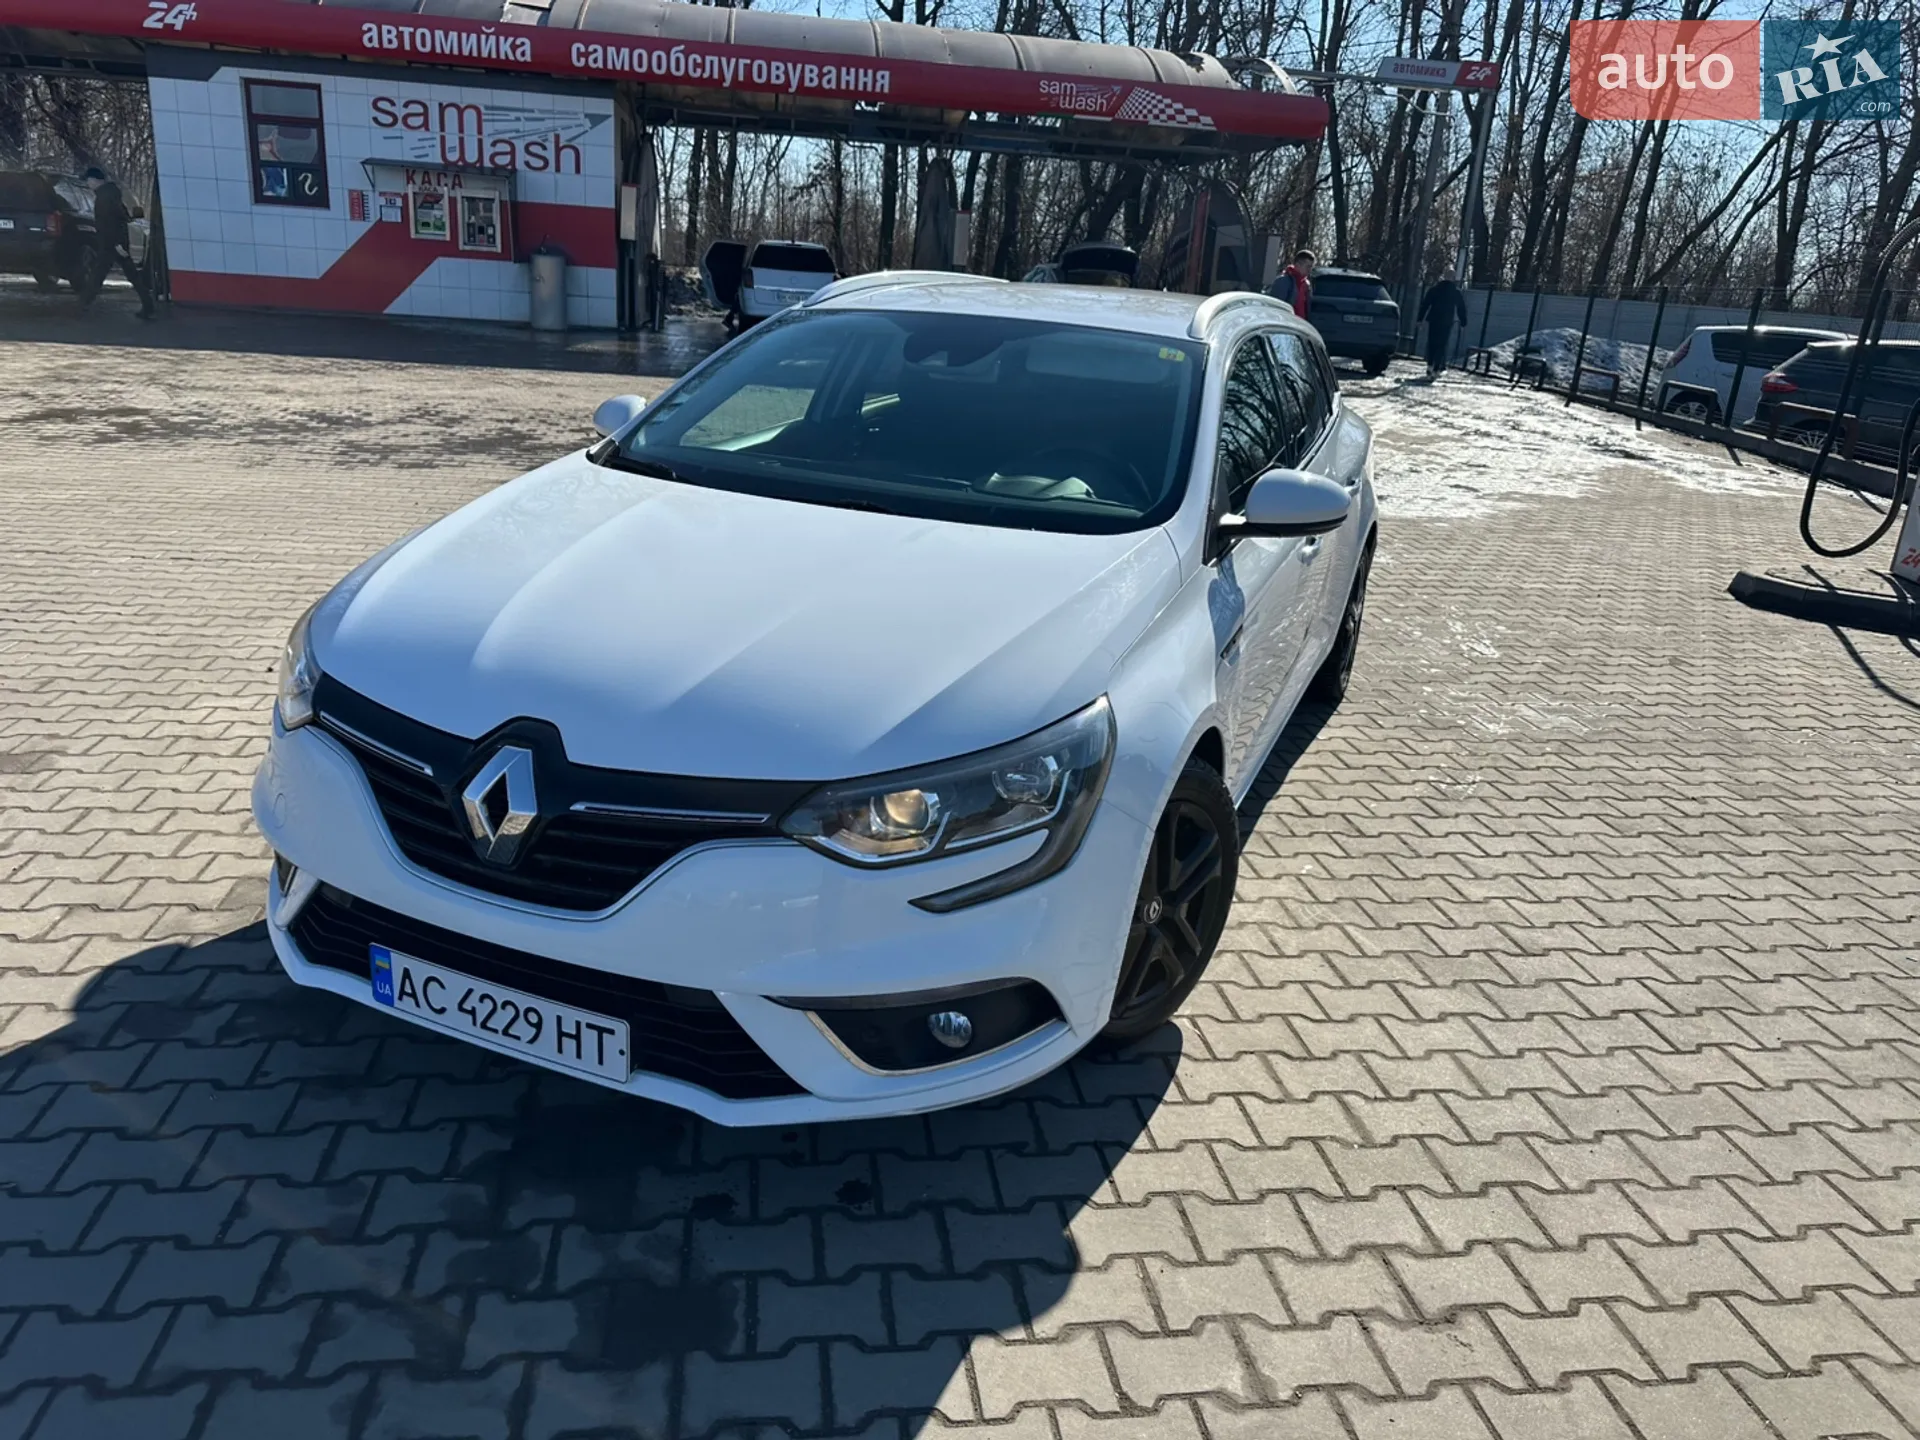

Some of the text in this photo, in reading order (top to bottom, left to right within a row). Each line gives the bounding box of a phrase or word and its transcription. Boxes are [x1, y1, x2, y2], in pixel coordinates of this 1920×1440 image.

[361, 22, 891, 94] автомийка самообслуговування
[1039, 79, 1077, 95] sam
[371, 96, 483, 135] sam
[1058, 94, 1107, 112] wash
[439, 133, 581, 174] wash
[405, 168, 463, 190] КАСА
[376, 980, 392, 997] UA
[397, 966, 616, 1066] AC 4229 HT
